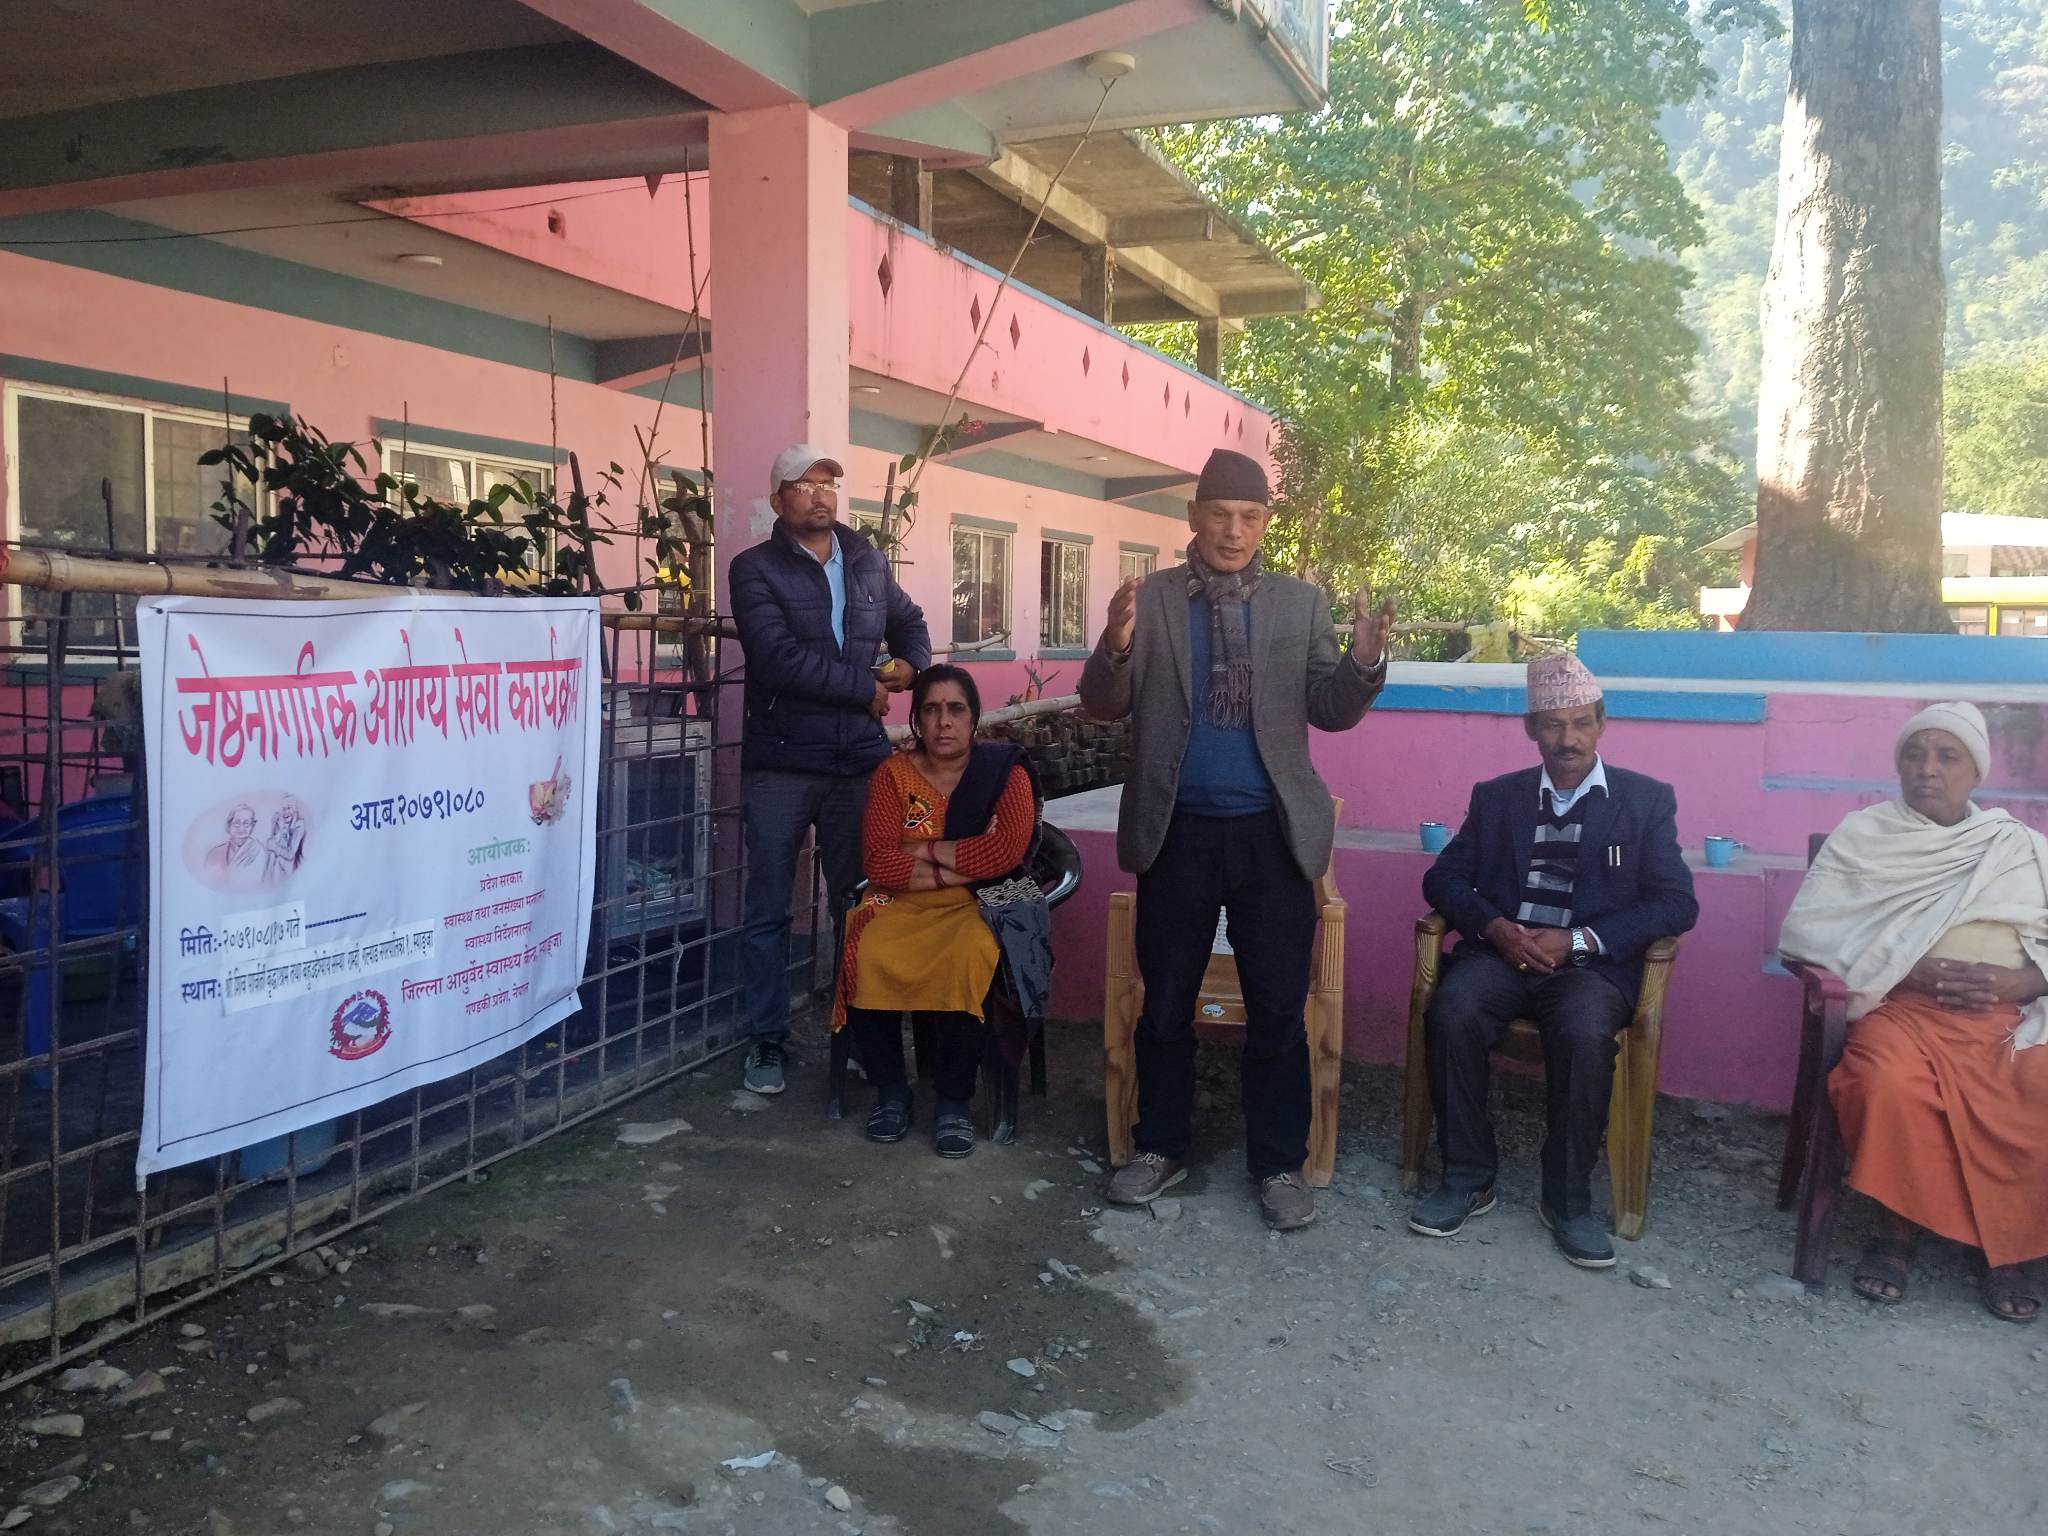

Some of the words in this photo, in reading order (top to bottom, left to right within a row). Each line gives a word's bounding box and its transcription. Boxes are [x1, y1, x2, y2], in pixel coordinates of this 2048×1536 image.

[176, 634, 357, 767] जेष्ठनागरिक
[364, 628, 451, 747] आरोग्य
[452, 627, 502, 744] सेवा
[505, 625, 582, 731] कार्यक्रम
[479, 873, 498, 892] प्रदेश
[499, 870, 523, 888] सरकार
[475, 905, 491, 921] तथा
[401, 978, 444, 1003] जिल्ला
[446, 959, 485, 995] आयुर्वेद
[485, 952, 522, 979] स्वास्थ्य
[465, 993, 491, 1016] गण्डकी
